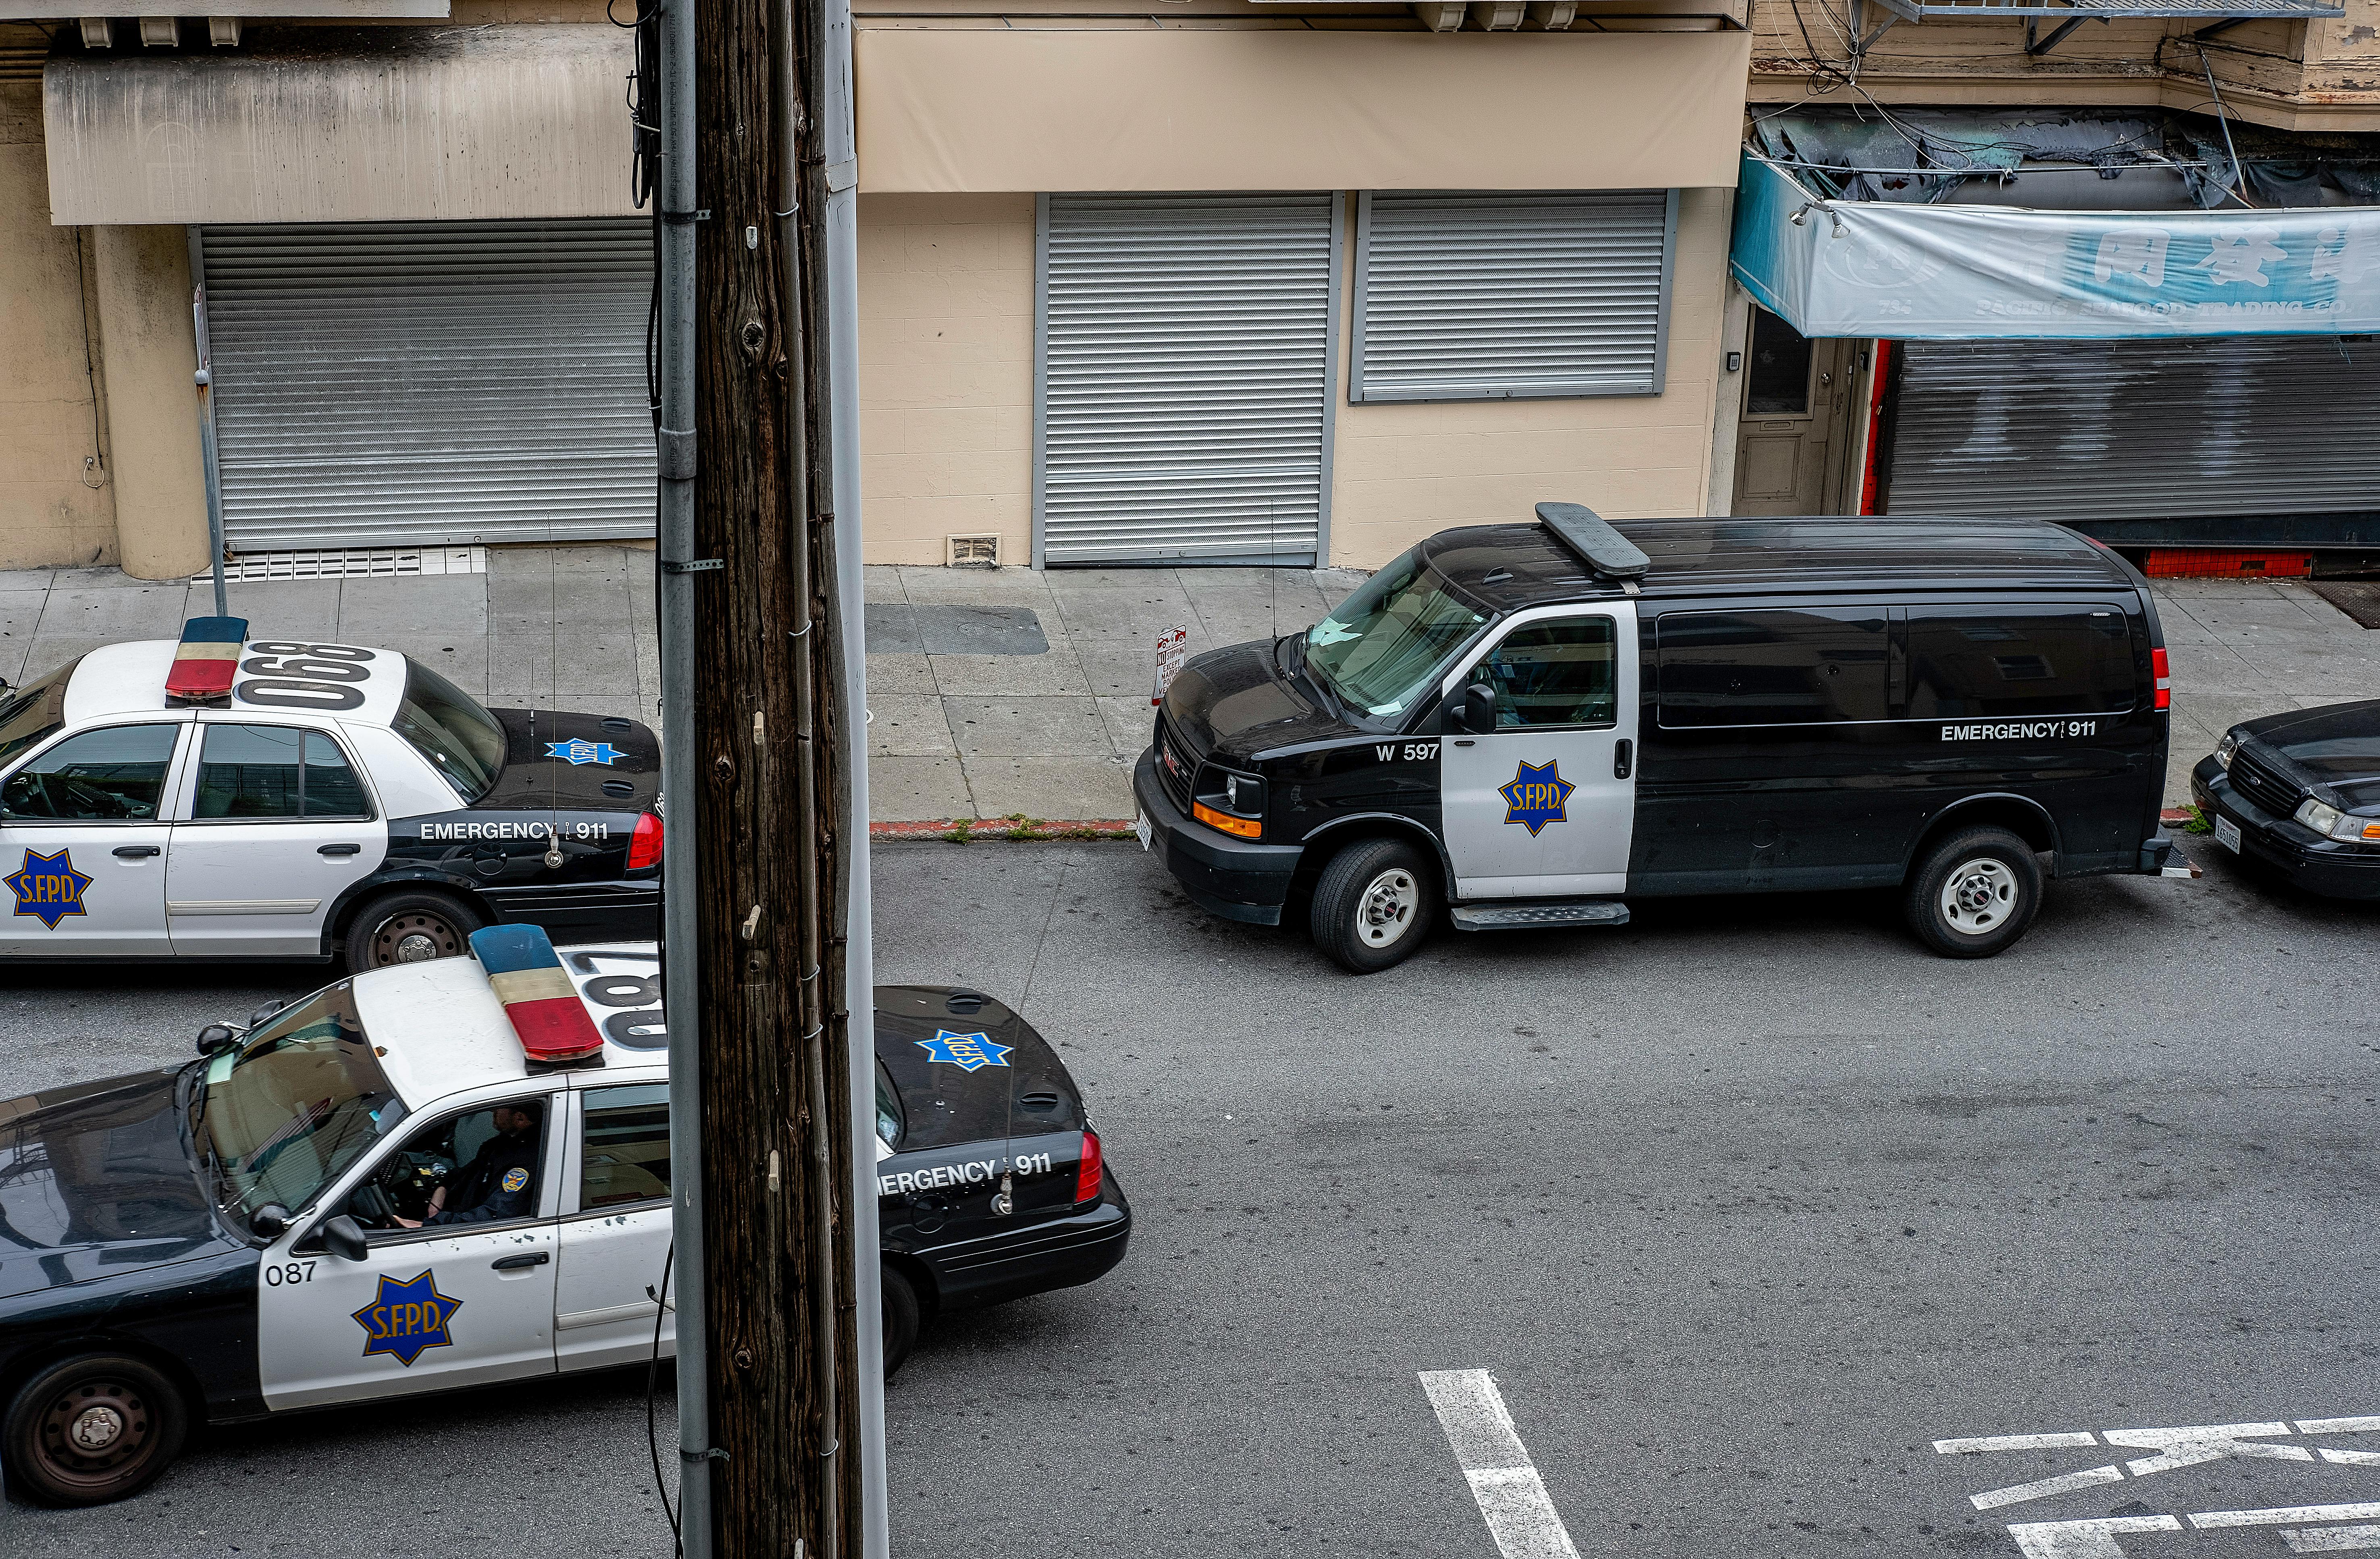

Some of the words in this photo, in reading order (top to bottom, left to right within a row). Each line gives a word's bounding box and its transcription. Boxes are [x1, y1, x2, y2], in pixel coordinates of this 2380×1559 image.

[1863, 243, 1911, 270] PS
[1878, 299, 1912, 315] 734
[1975, 299, 2069, 316] PACIFIC
[2079, 301, 2186, 316] SEAFOOD
[2198, 301, 2303, 316] TRADING
[1157, 652, 1166, 666] NO
[1167, 645, 1185, 661] STOPPING
[1163, 659, 1180, 672] EXCEPT
[233, 642, 377, 711] 068
[1941, 722, 2060, 741] EMERGENCY
[2069, 721, 2096, 736] 911
[1163, 745, 1179, 778] GMC
[1376, 746, 1394, 761] W
[1404, 743, 1440, 760] 597
[420, 822, 558, 840] EMERGENCY
[576, 822, 607, 840] 911
[20, 874, 77, 904] S.F.P.D.
[878, 1159, 996, 1196] ERGENCY
[1015, 1152, 1052, 1175] 911
[265, 1260, 316, 1287] 087
[371, 1300, 443, 1341] S.F.P.D.
